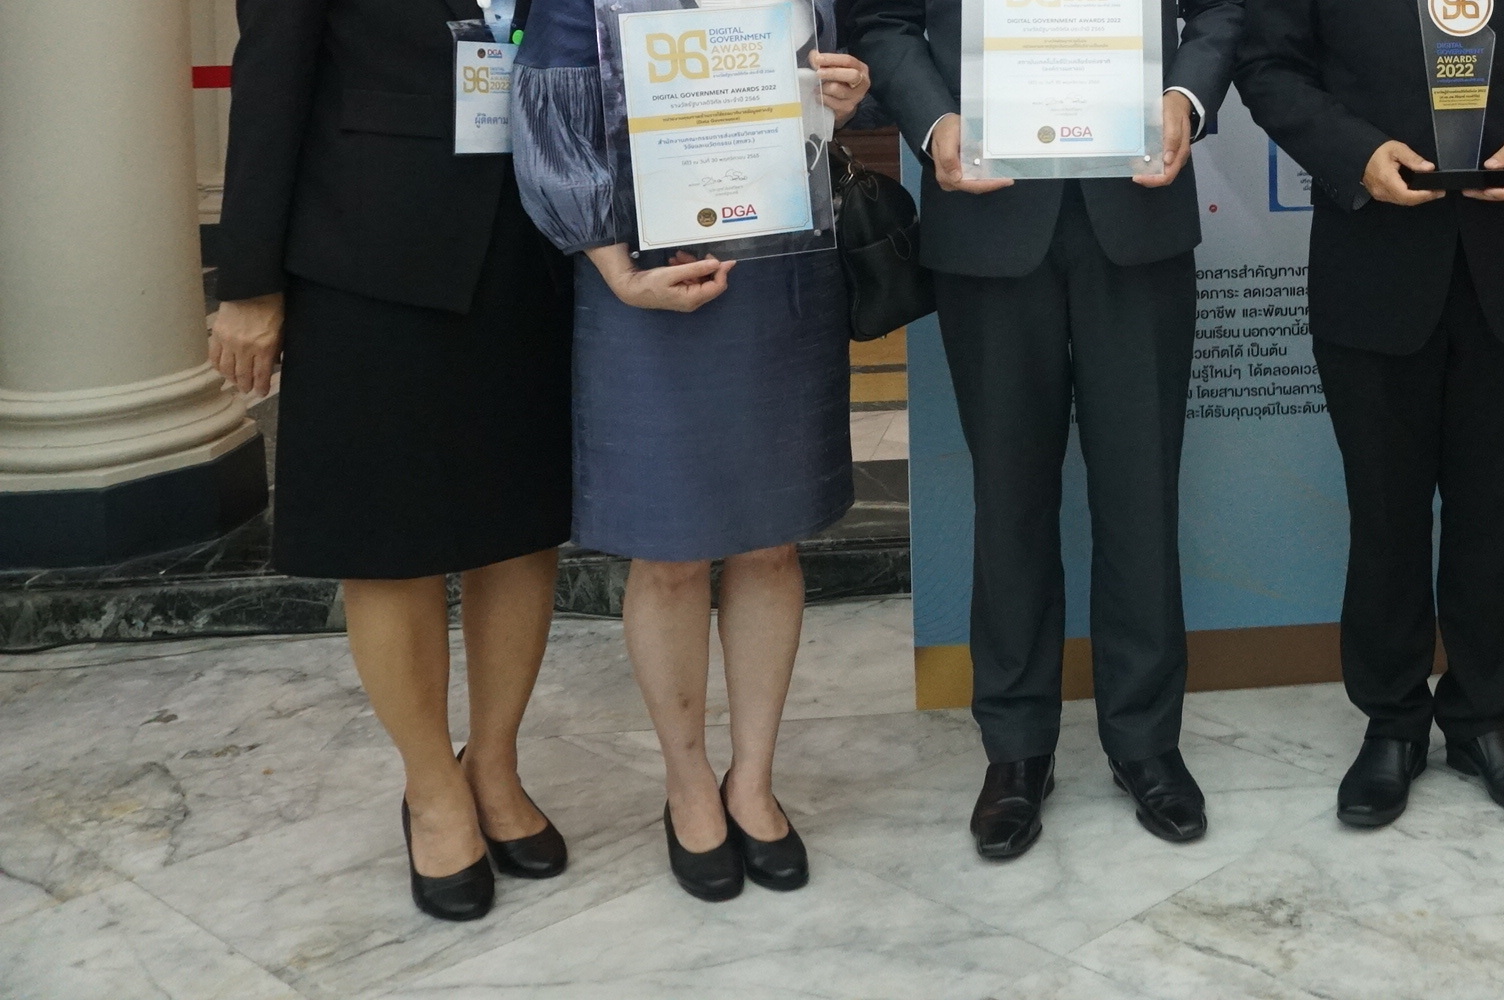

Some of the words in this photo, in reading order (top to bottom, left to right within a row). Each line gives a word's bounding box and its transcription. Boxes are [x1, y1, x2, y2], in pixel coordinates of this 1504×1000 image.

[709, 27, 744, 36] DIGITAL
[709, 32, 772, 44] GOVERNMENT
[711, 42, 764, 54] AWARDS
[711, 53, 761, 71] 2022
[1437, 55, 1477, 64] AWARDS
[1436, 63, 1474, 78] 2022
[652, 92, 679, 101] DIGITAL
[680, 89, 729, 99] GOVERNMENT
[731, 86, 760, 95] AWARDS
[761, 84, 777, 92] 2022
[1060, 126, 1093, 137] DGA
[721, 203, 757, 219] DGA
[1247, 342, 1287, 357] เป็นต้น
